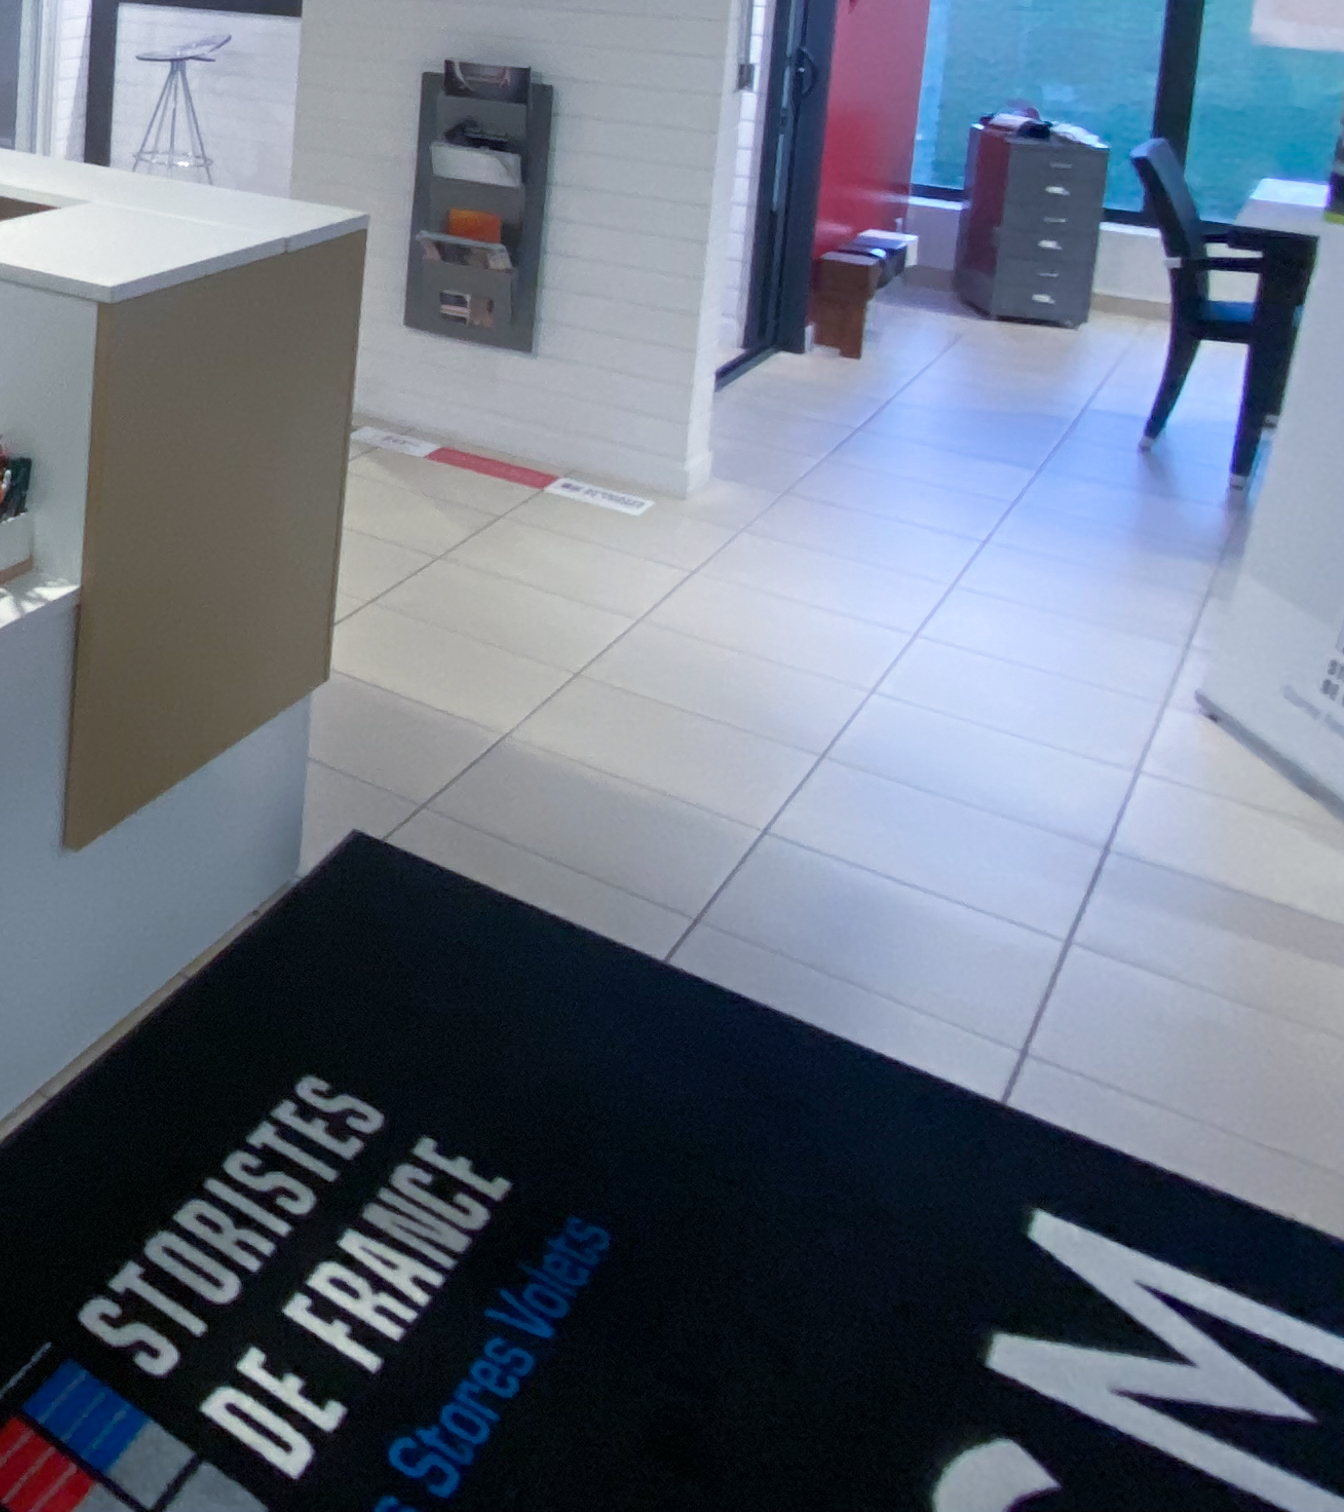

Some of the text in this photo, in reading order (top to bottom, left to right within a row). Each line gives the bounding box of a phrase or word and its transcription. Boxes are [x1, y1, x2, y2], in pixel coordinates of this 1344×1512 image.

[78, 1076, 385, 1377] STORISTES
[199, 1135, 512, 1480] DE FRANCE
[388, 1216, 611, 1499] Stores Volets
[932, 1207, 1344, 1512] M
